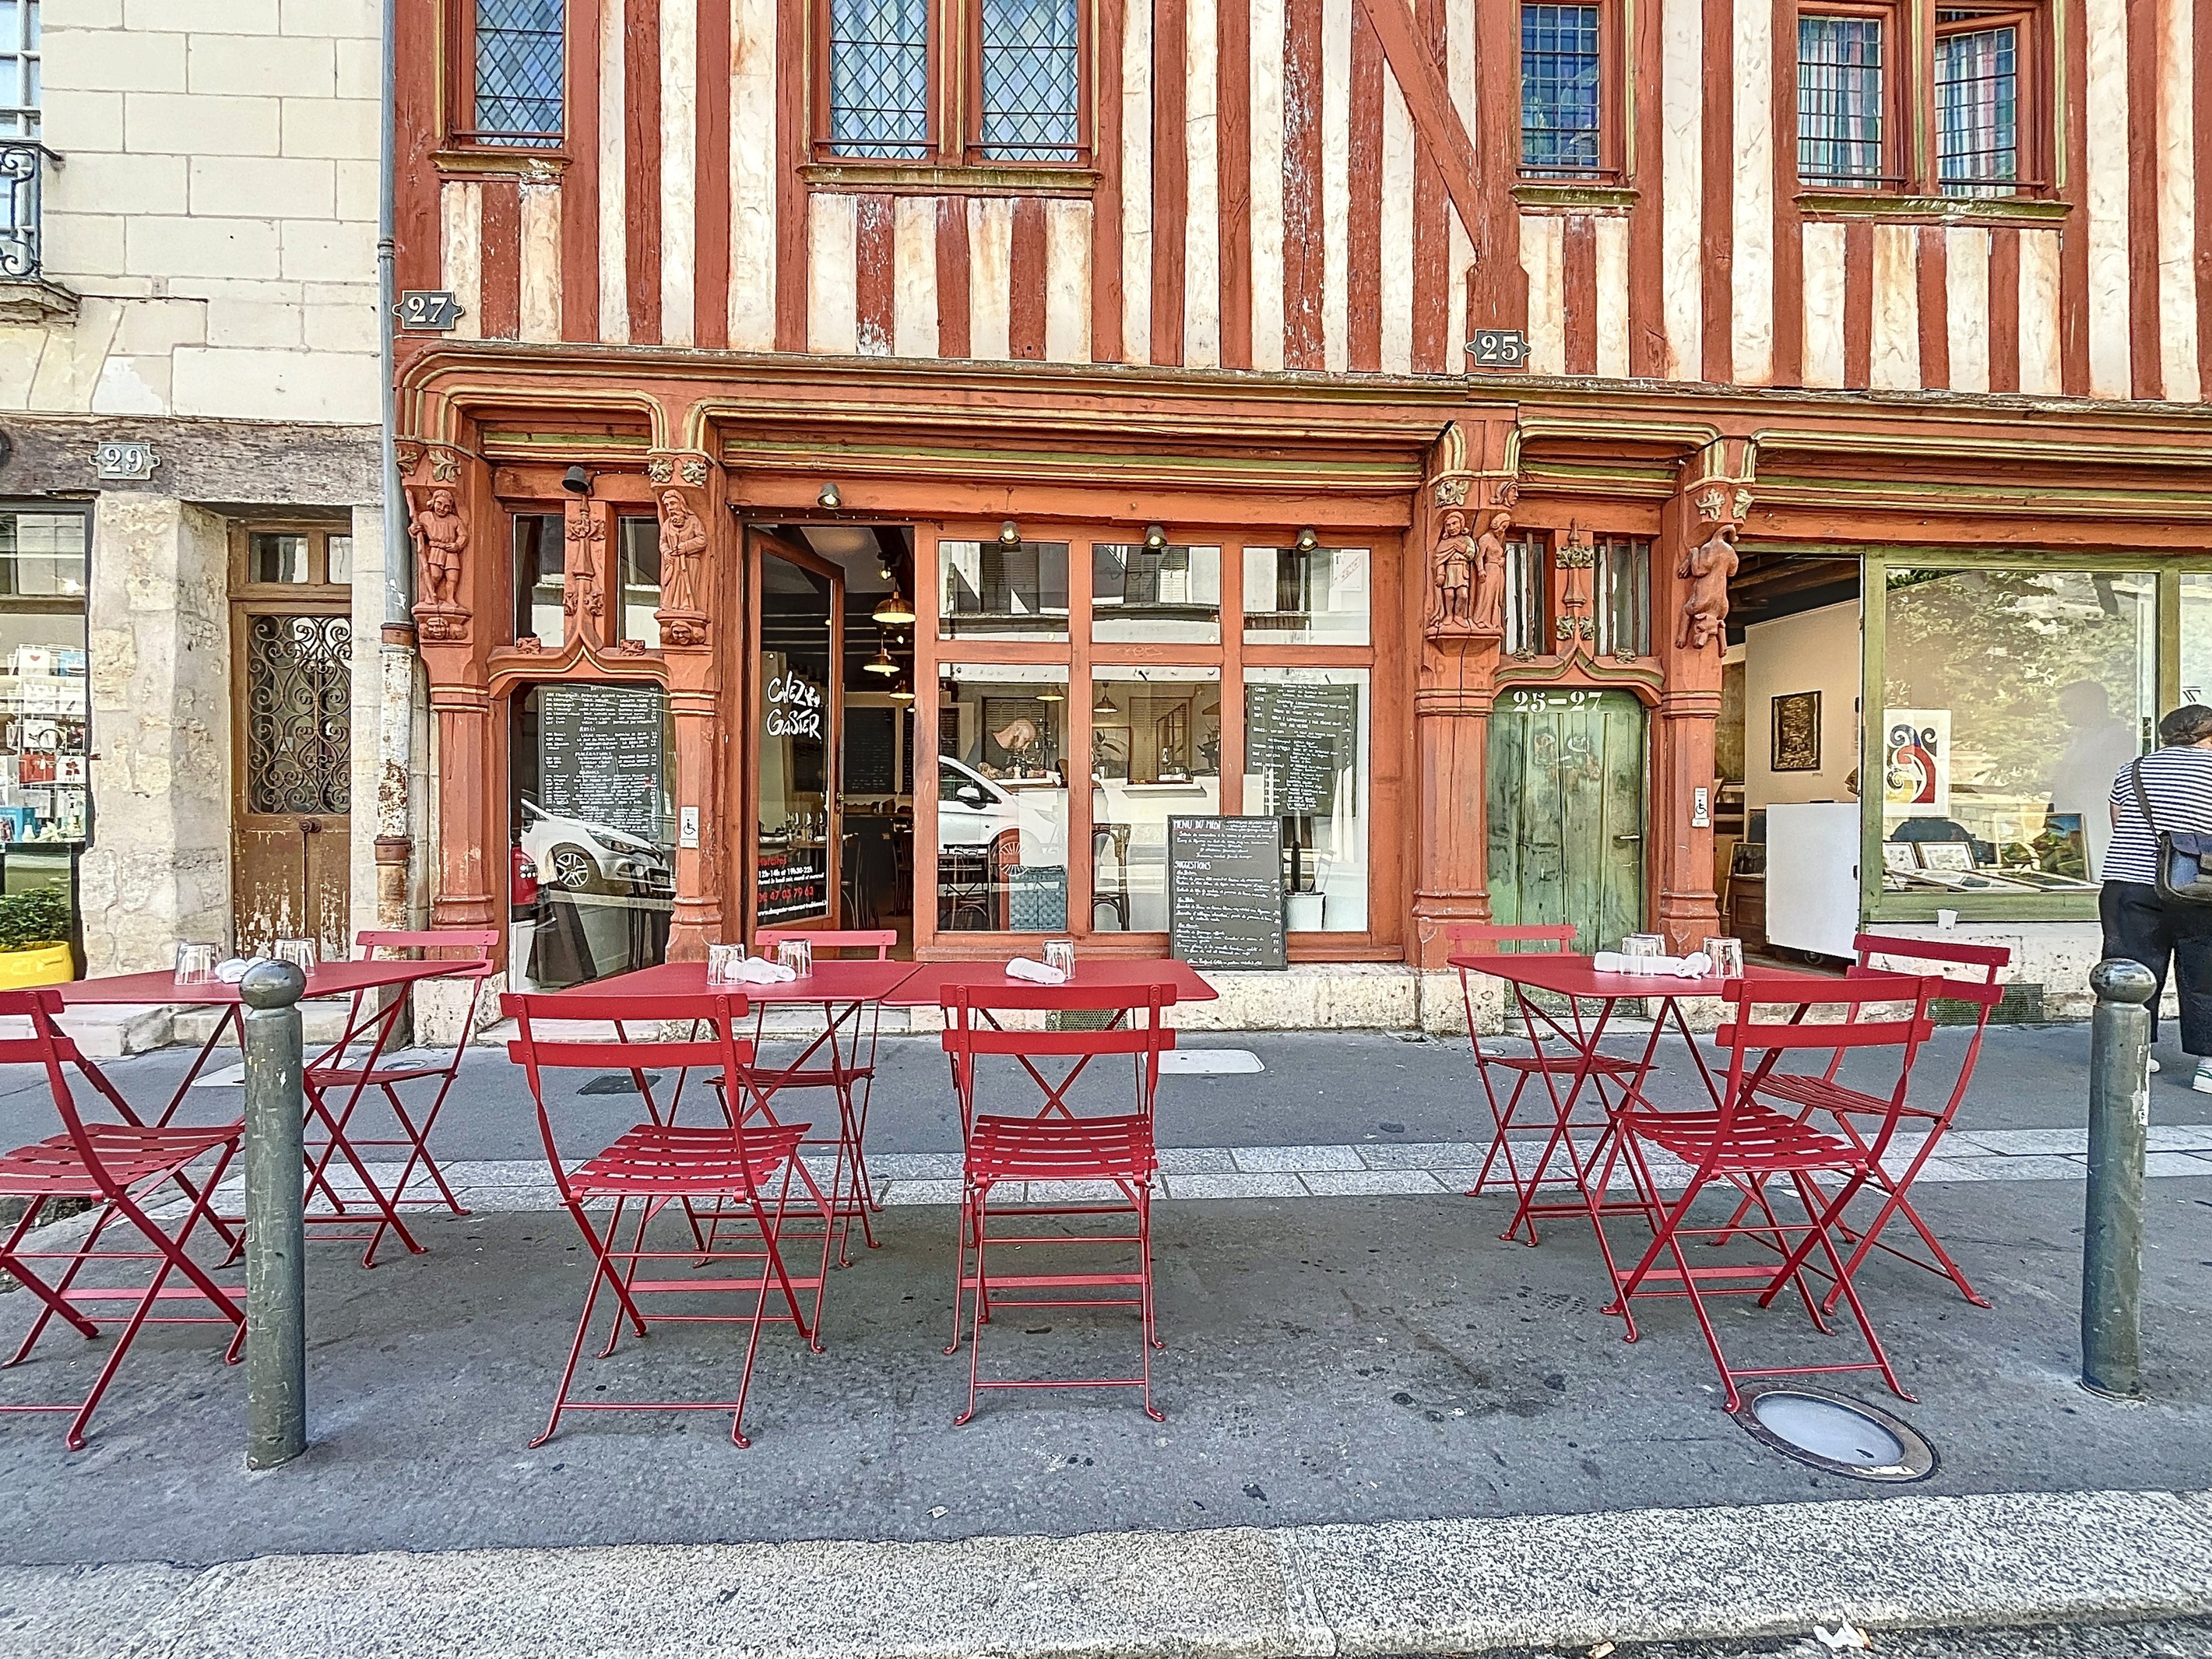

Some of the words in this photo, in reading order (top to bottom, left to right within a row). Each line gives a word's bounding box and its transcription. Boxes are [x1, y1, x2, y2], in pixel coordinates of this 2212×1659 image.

[408, 297, 448, 322] 27
[1481, 335, 1518, 361] 25
[104, 448, 143, 473] 29
[1513, 691, 1603, 713] 25-27
[767, 708, 821, 740] GASTER
[1173, 820, 1193, 830] MENU
[1195, 820, 1204, 830] DU
[1206, 820, 1221, 831] MIDI
[1174, 860, 1211, 870] SUGGESTIONS
[770, 889, 779, 901] 47
[794, 887, 804, 898] 79
